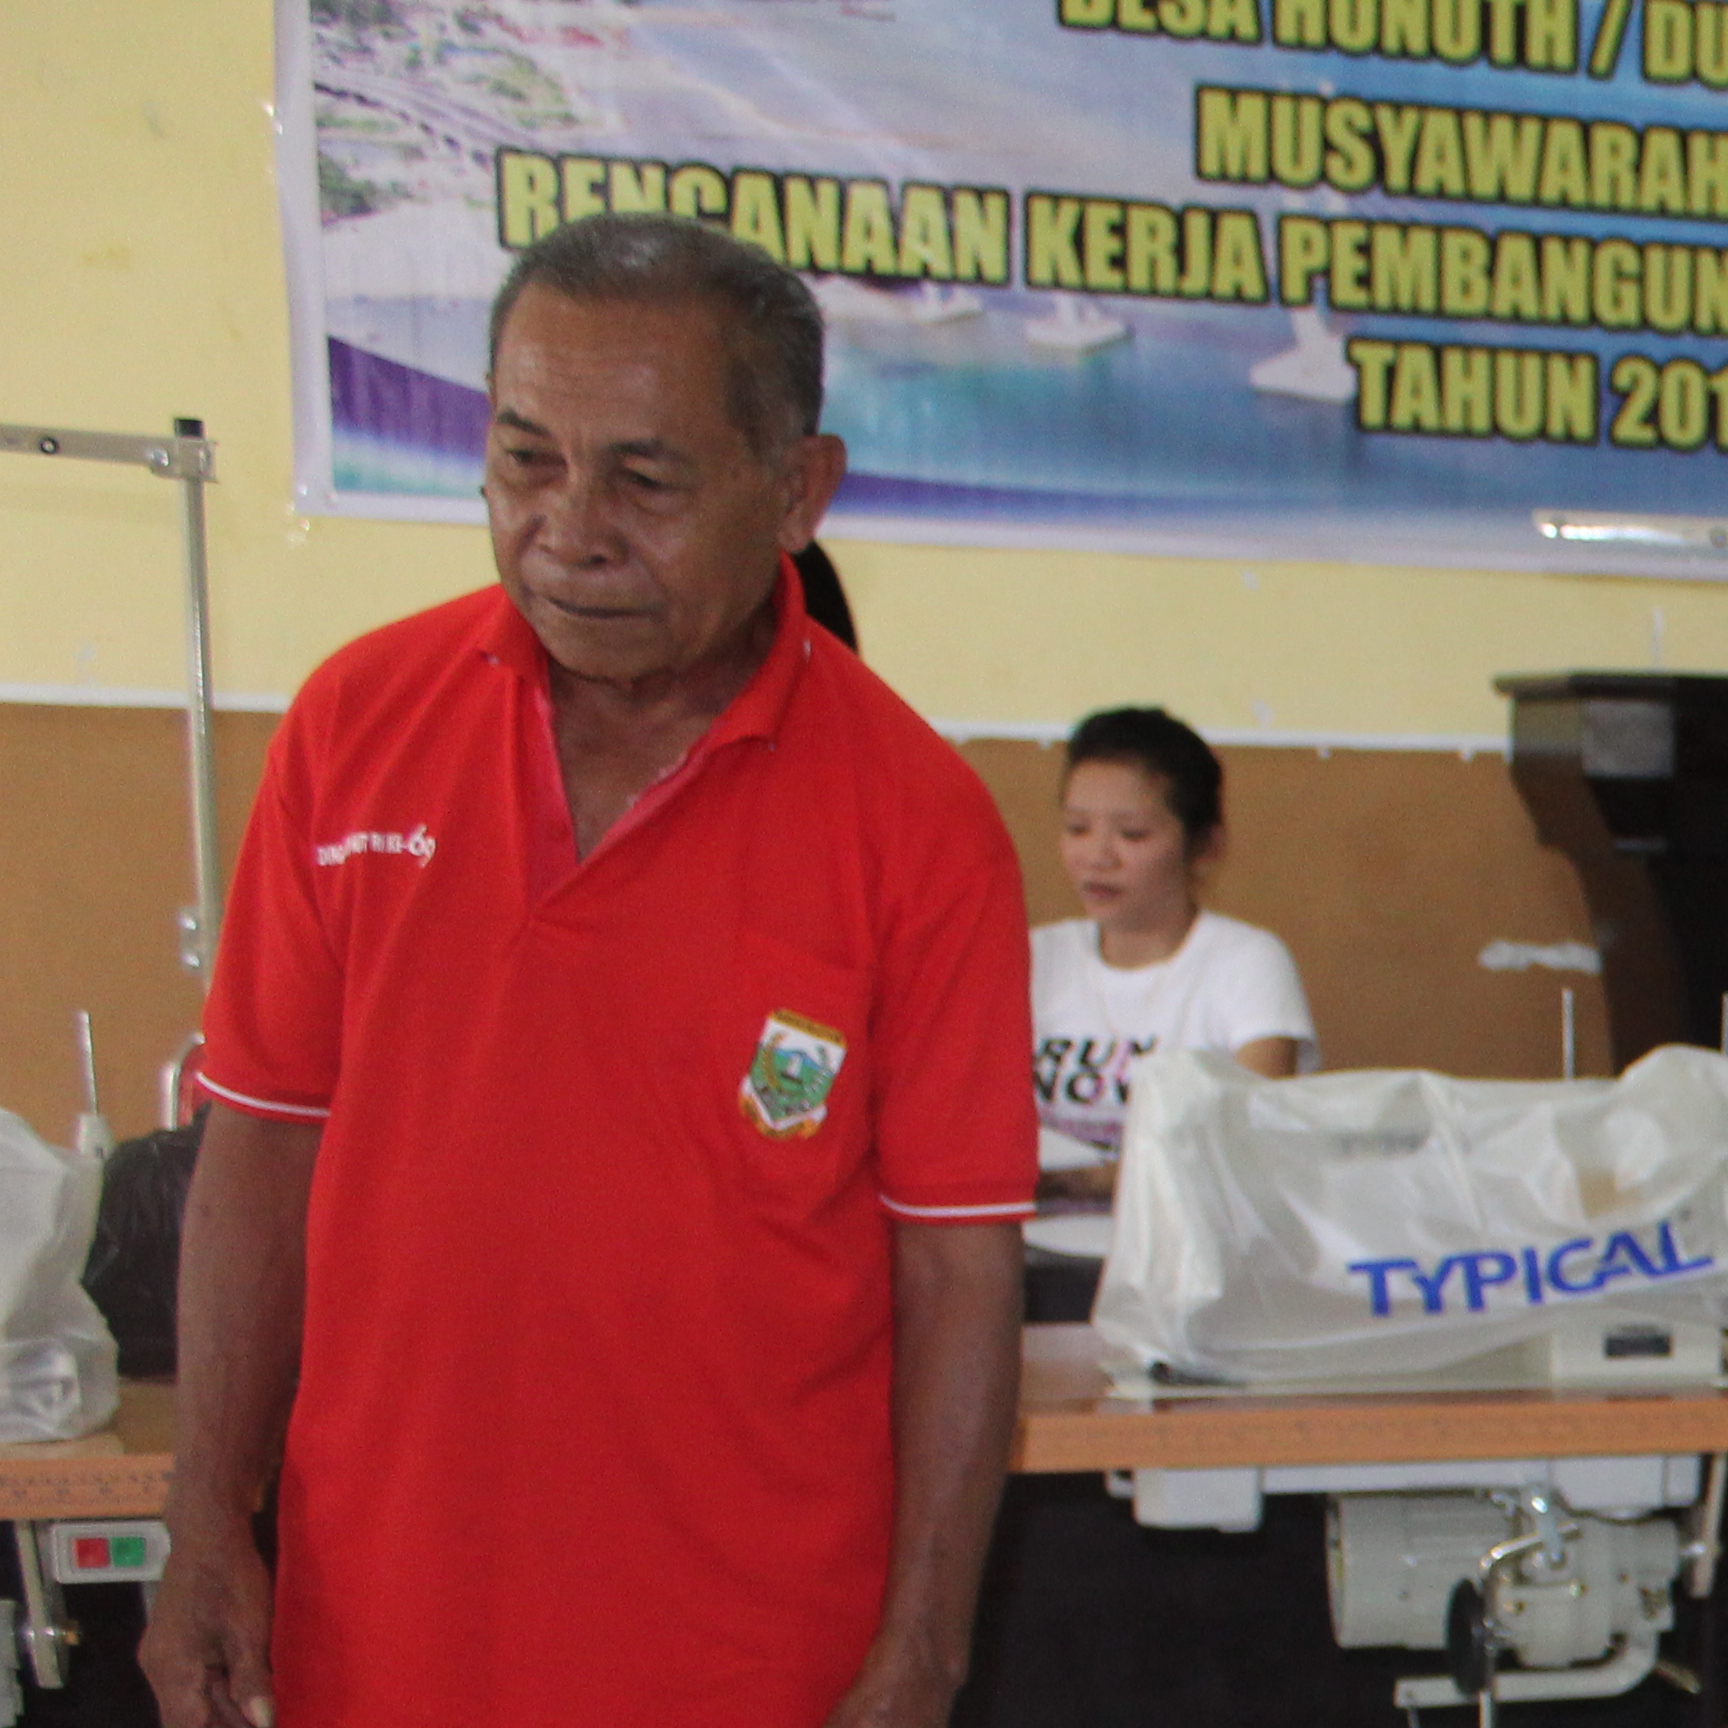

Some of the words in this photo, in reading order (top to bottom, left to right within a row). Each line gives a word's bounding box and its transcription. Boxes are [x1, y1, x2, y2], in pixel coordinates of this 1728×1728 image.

[1023, 187, 1269, 306] KERJA
[1347, 337, 1599, 447] TAHUN
[1346, 1218, 1714, 1317] TYPICAL
